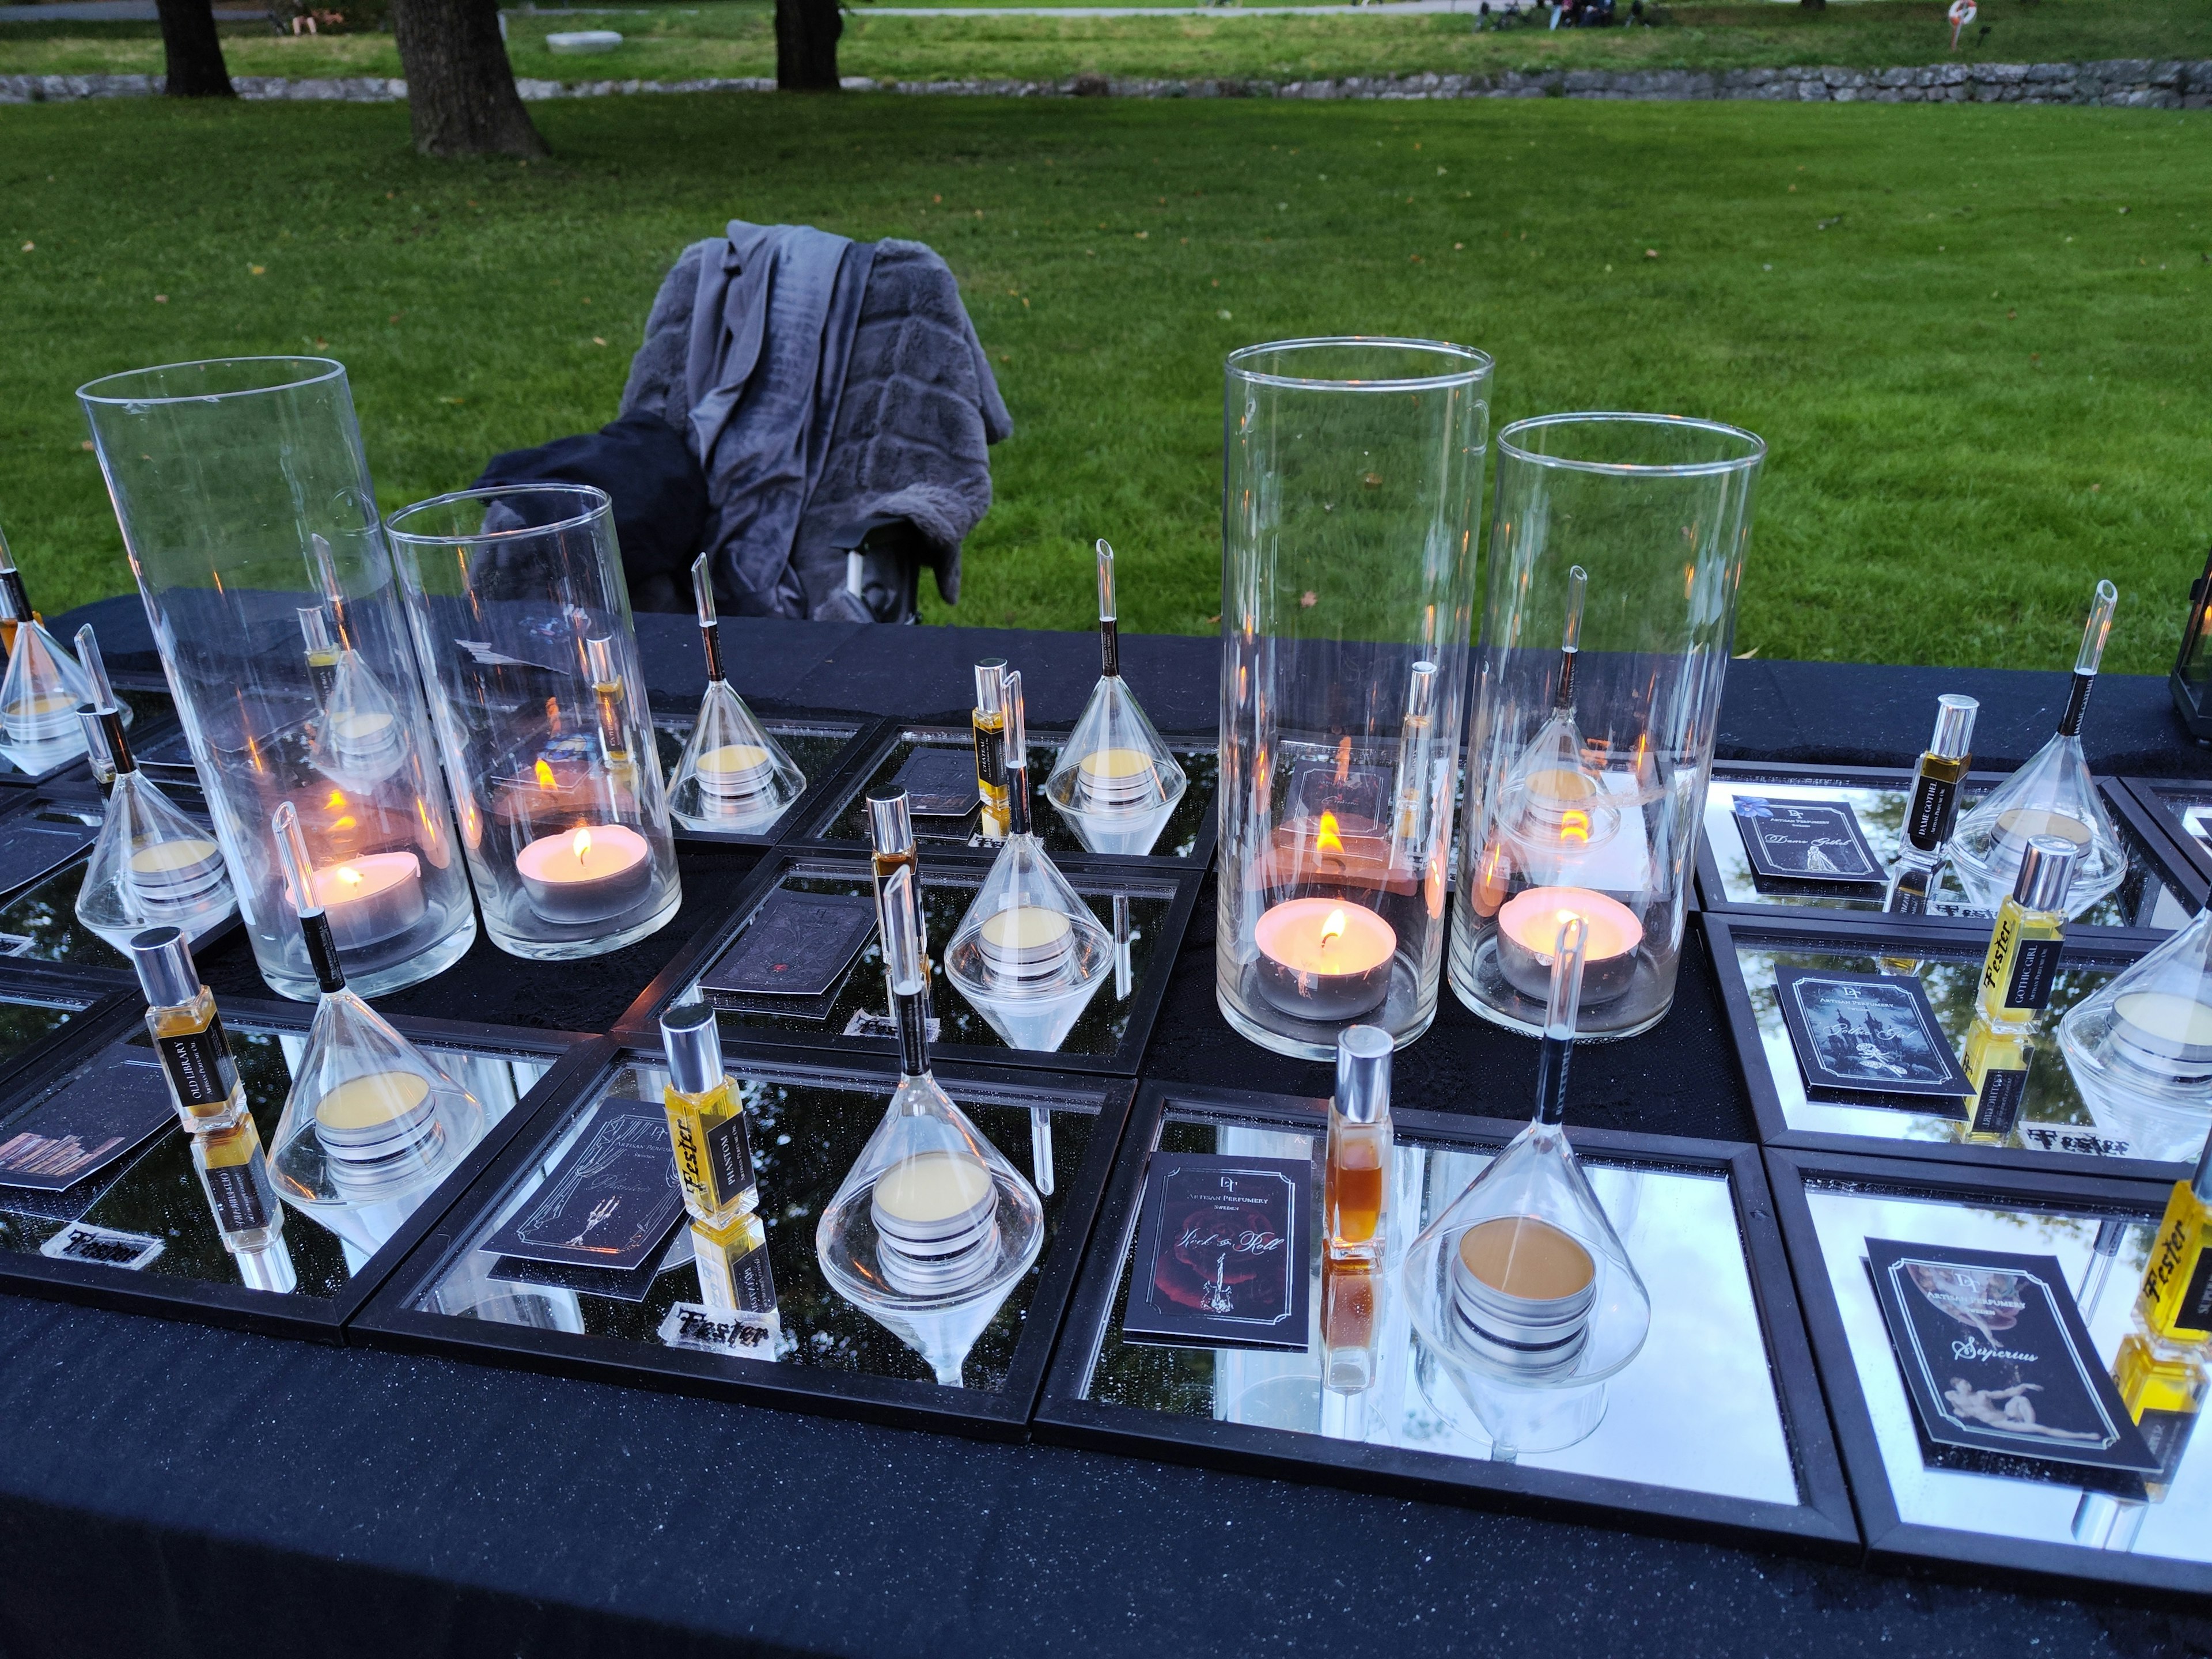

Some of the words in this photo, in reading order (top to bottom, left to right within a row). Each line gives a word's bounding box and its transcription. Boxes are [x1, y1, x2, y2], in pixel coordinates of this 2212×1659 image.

[1918, 813, 1930, 835] DAME
[1925, 782, 1937, 813] GOTHEL
[1764, 834, 1808, 844] Dame
[1810, 837, 1851, 846] Gothel
[2015, 968, 2032, 1003] GOTHIC
[2025, 945, 2037, 967] GIRL
[1851, 1000, 1893, 1008] PERFUMERY
[1823, 1023, 1872, 1036] Gothic
[1877, 1028, 1918, 1040] Girl
[174, 1041, 195, 1080] LIBRARY
[189, 1081, 202, 1099] OLD
[1556, 1085, 1567, 1115] ROCK
[720, 1135, 736, 1185] PHANTOM
[1223, 1195, 1268, 1205] PERFUMERY
[1176, 1227, 1219, 1249] Rock
[1232, 1230, 1285, 1255] Roll
[1926, 1291, 1968, 1302] ARTISAN
[1969, 1297, 2026, 1309] PERFUMERY
[1951, 1336, 2039, 1362] Superius
